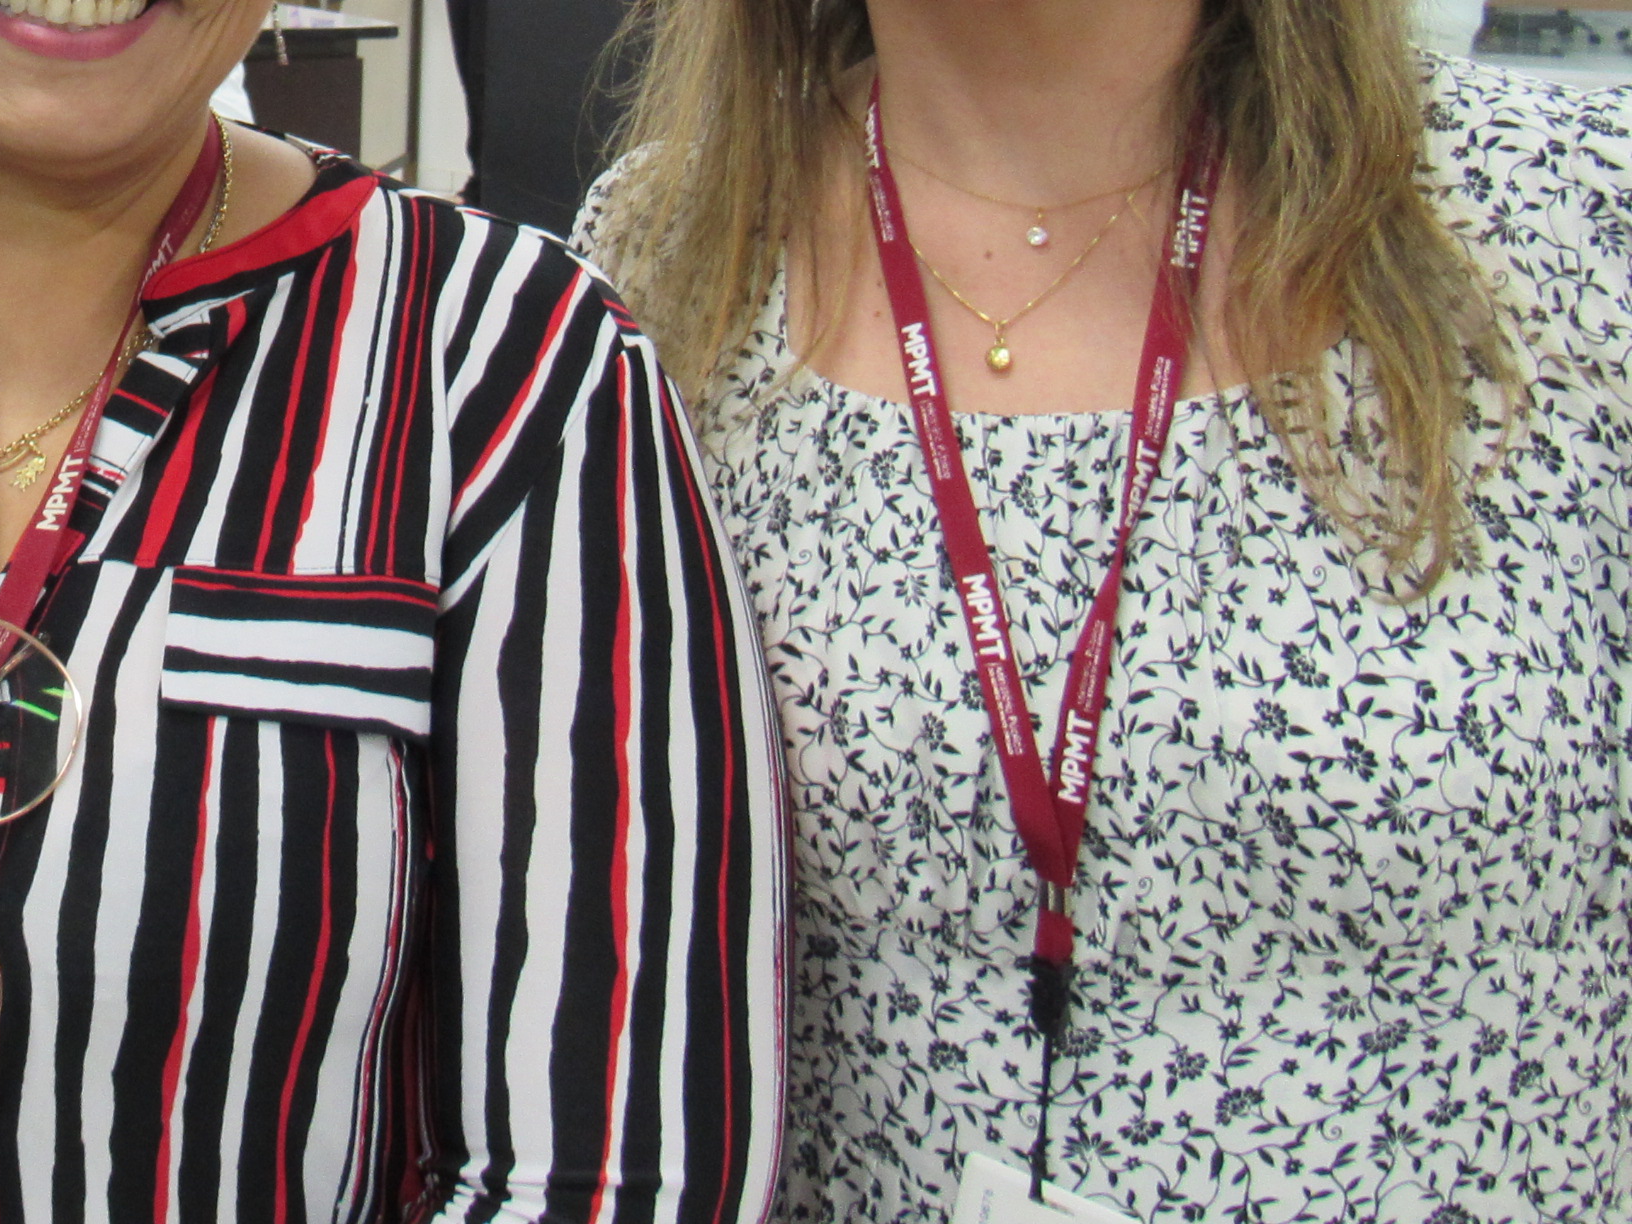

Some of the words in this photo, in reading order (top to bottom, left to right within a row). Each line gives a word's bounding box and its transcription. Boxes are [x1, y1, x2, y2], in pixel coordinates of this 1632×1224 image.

[901, 322, 937, 396] MPMT
[36, 454, 84, 531] MPMT
[963, 573, 1007, 660] MPMT
[1057, 709, 1093, 804] MPMT
